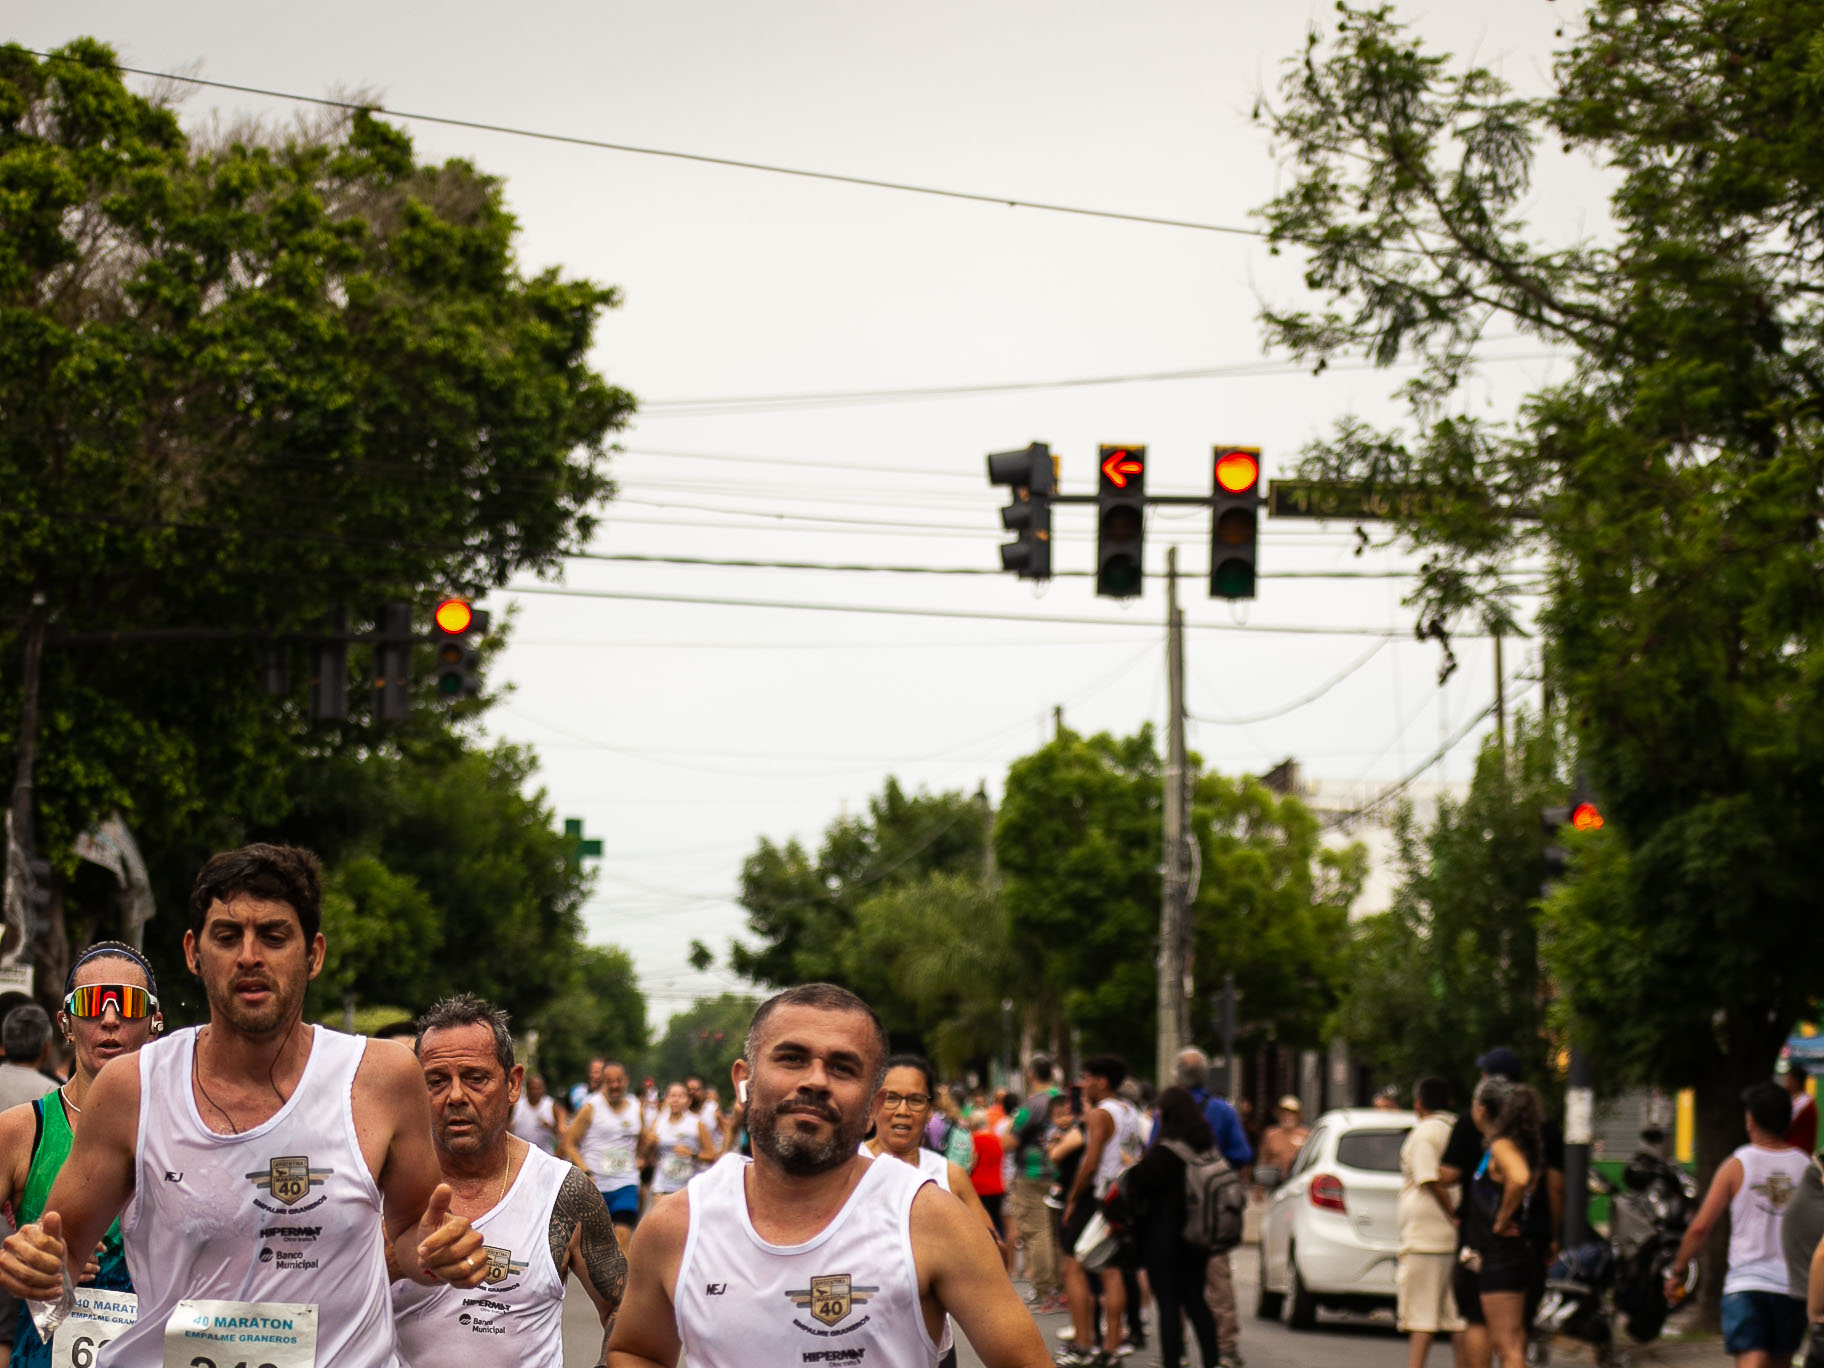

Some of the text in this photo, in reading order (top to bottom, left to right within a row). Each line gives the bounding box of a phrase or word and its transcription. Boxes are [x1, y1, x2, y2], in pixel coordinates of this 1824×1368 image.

[279, 1182, 302, 1196] 40
[276, 1250, 304, 1260] Banco
[276, 1259, 319, 1270] Municipal
[706, 1283, 727, 1296] NEJ
[76, 1299, 136, 1313] 40 MARAT
[820, 1301, 843, 1316] 40
[112, 1316, 137, 1326] GRAN
[193, 1315, 293, 1330] 40 MARATON
[472, 1325, 506, 1335] Municipal
[184, 1330, 297, 1344] EMPALME GRANEROS
